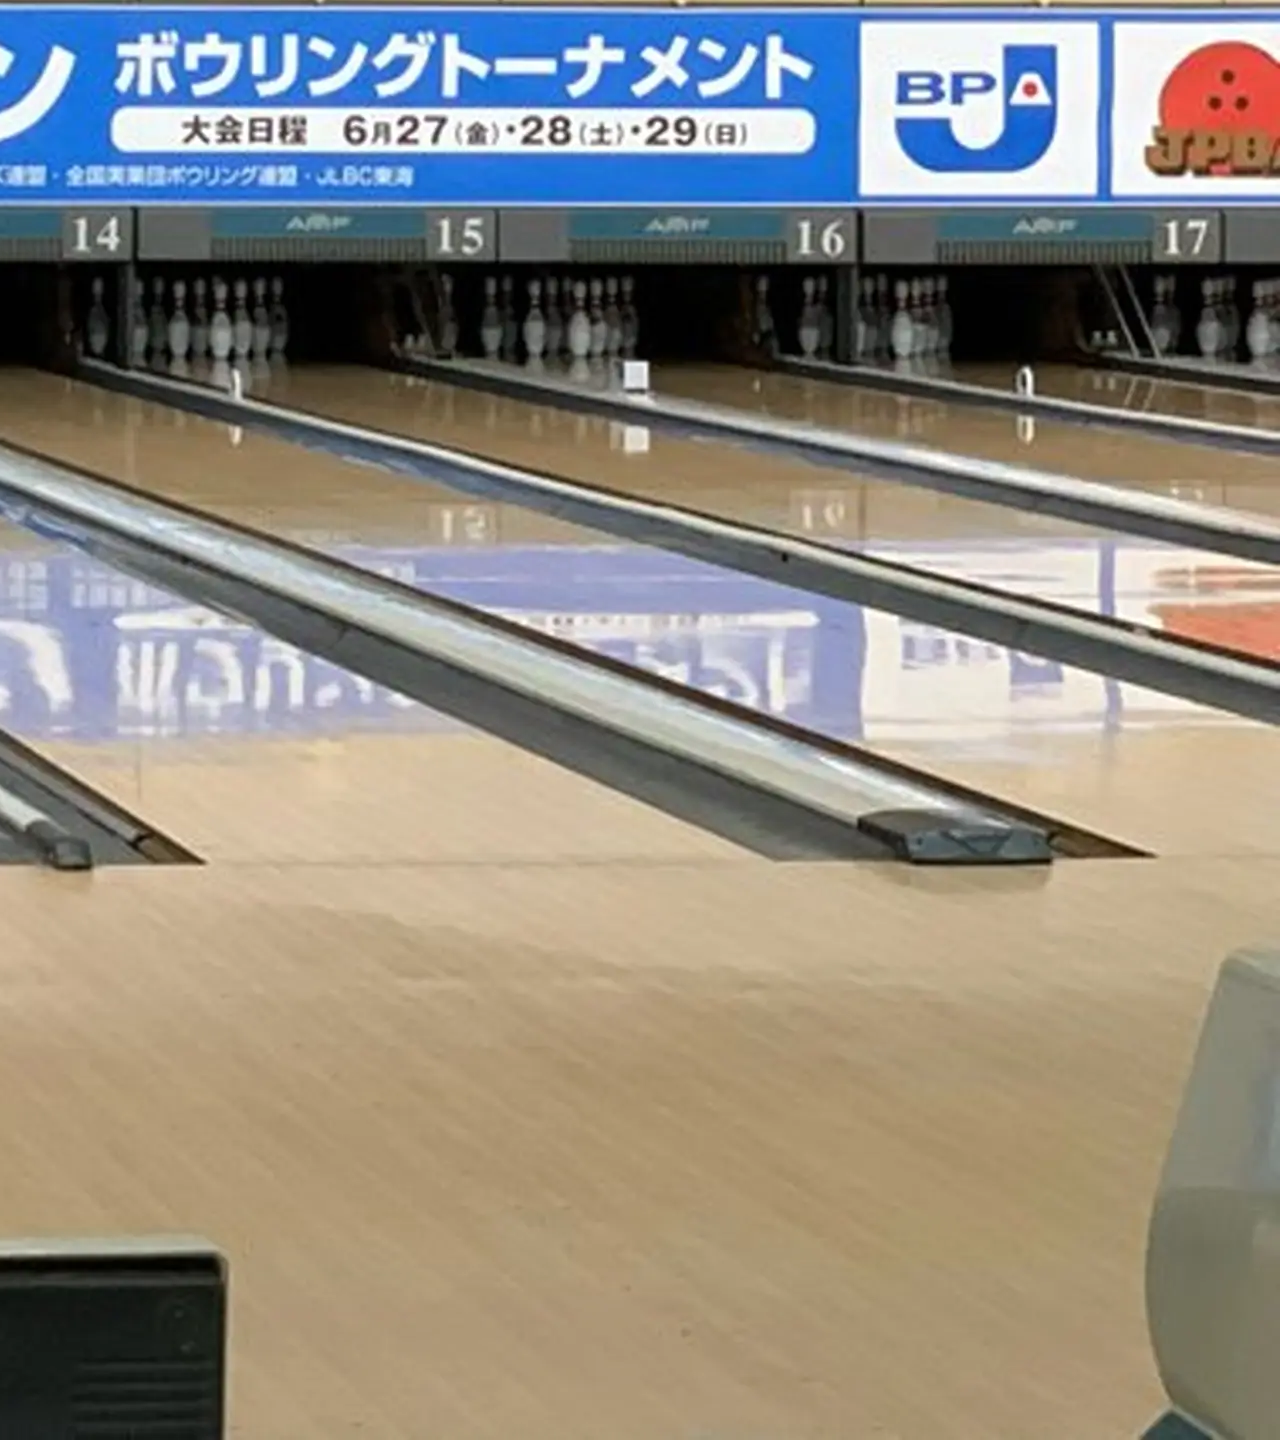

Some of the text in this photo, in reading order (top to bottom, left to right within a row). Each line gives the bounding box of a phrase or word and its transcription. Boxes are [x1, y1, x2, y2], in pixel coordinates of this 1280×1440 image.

[114, 30, 814, 99] ボウリングトーナメント
[182, 115, 308, 145] 大会日程
[73, 216, 121, 252] 14
[438, 217, 484, 255] 15
[796, 219, 845, 255] 16
[1163, 219, 1209, 255] 17
